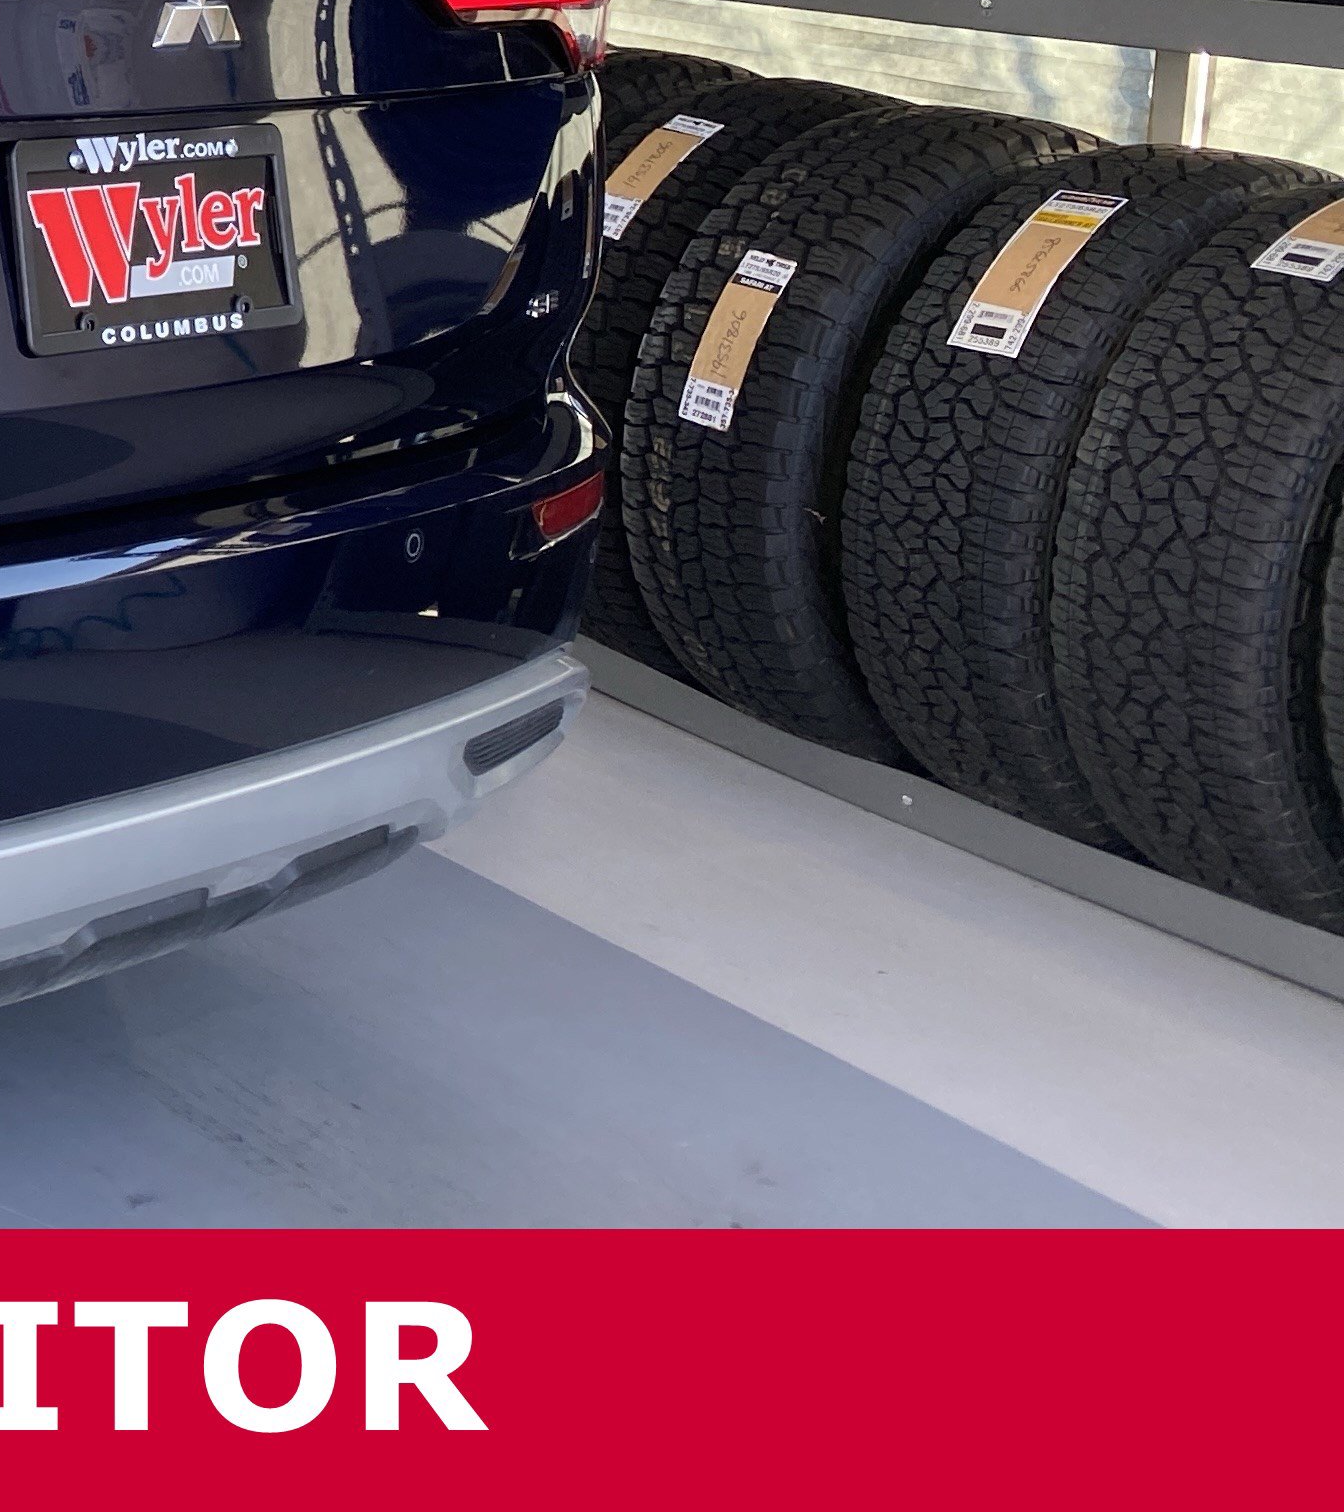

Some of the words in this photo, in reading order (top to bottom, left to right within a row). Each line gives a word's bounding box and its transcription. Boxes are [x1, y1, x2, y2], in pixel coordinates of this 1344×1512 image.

[27, 172, 265, 308] Wyler
[101, 313, 244, 346] COLUMBUS
[709, 309, 748, 380] 19531806
[967, 334, 1001, 347] 255389
